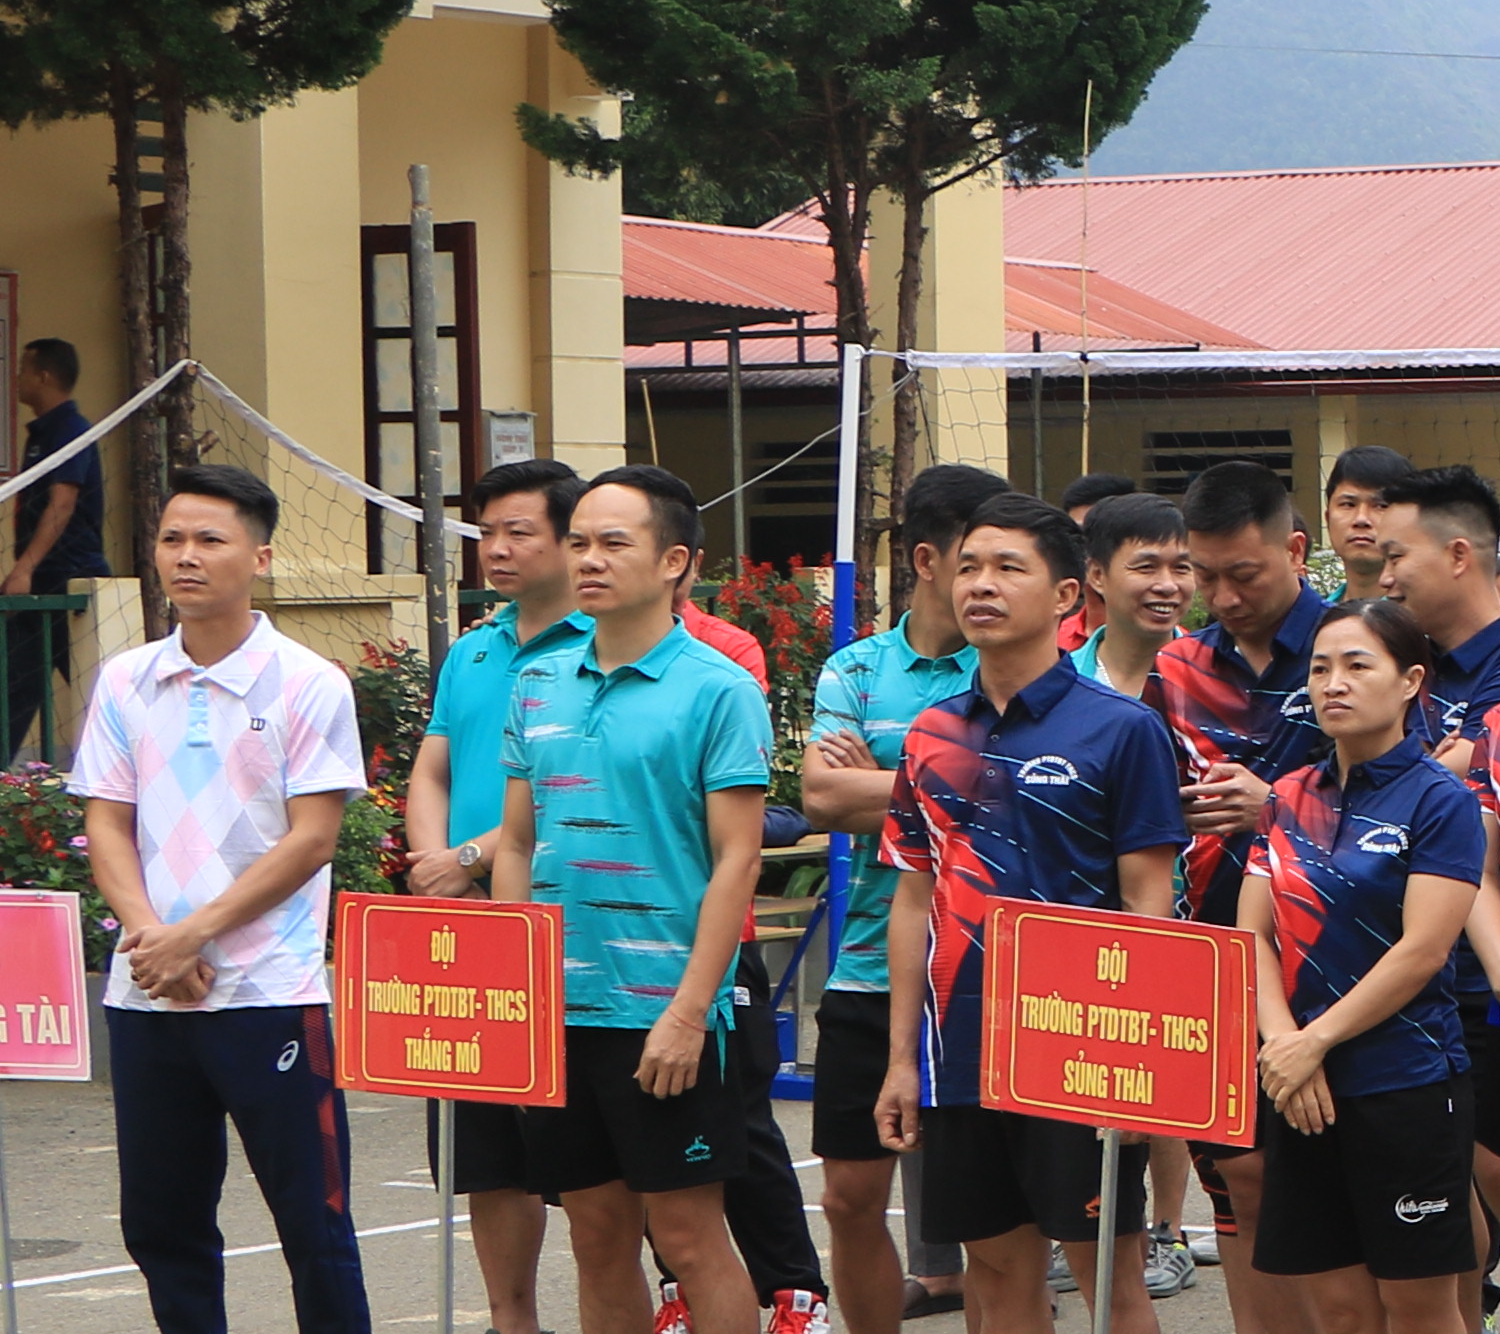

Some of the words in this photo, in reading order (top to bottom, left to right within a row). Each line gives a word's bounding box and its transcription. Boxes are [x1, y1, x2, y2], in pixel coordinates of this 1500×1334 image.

[431, 924, 456, 970] ĐỘI
[1096, 941, 1128, 990] ĐỘI
[16, 995, 72, 1045] TÀI
[367, 974, 421, 1016] TRƯỜNG
[423, 984, 483, 1019] PTDTBT-
[485, 988, 527, 1022] THCS
[1020, 990, 1084, 1037] TRƯỜNG
[1086, 1004, 1157, 1046] PTDTBT-
[1161, 1014, 1209, 1053] THCS
[404, 1026, 452, 1072] THẮNG
[455, 1031, 481, 1074] MỐ
[1063, 1049, 1109, 1099] SỦNG
[1112, 1062, 1154, 1105] THÀI
